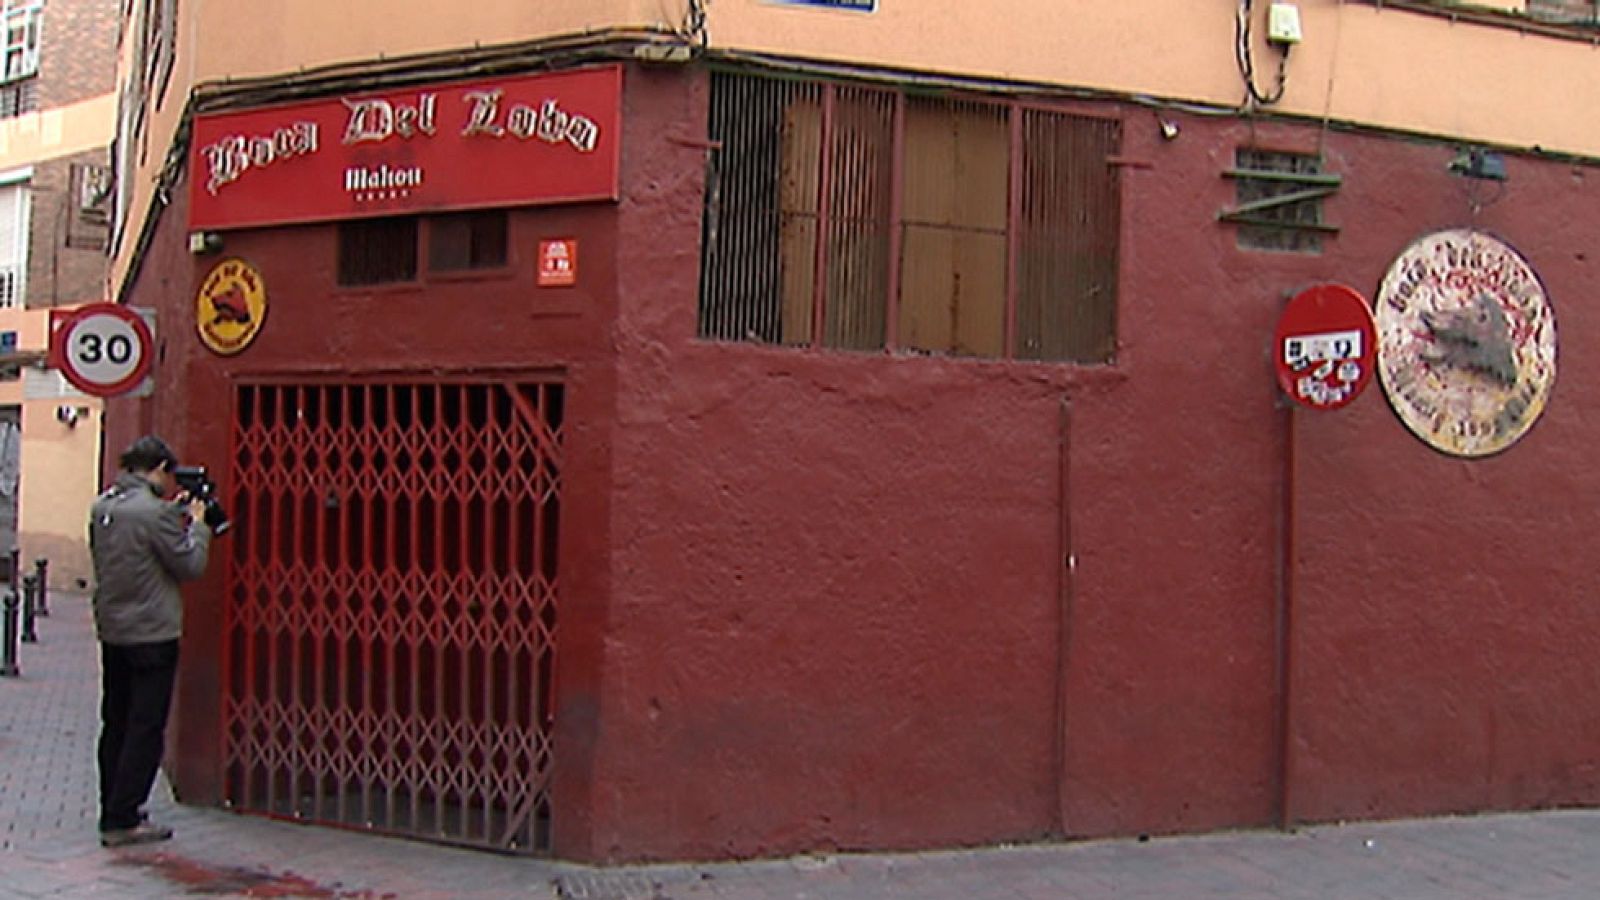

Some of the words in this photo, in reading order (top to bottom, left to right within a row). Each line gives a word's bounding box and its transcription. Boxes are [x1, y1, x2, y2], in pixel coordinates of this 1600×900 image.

[201, 121, 318, 196] Boca
[341, 93, 437, 145] Del
[461, 89, 598, 151] Lobo
[345, 164, 422, 191] Mahou
[79, 333, 132, 364] 30
